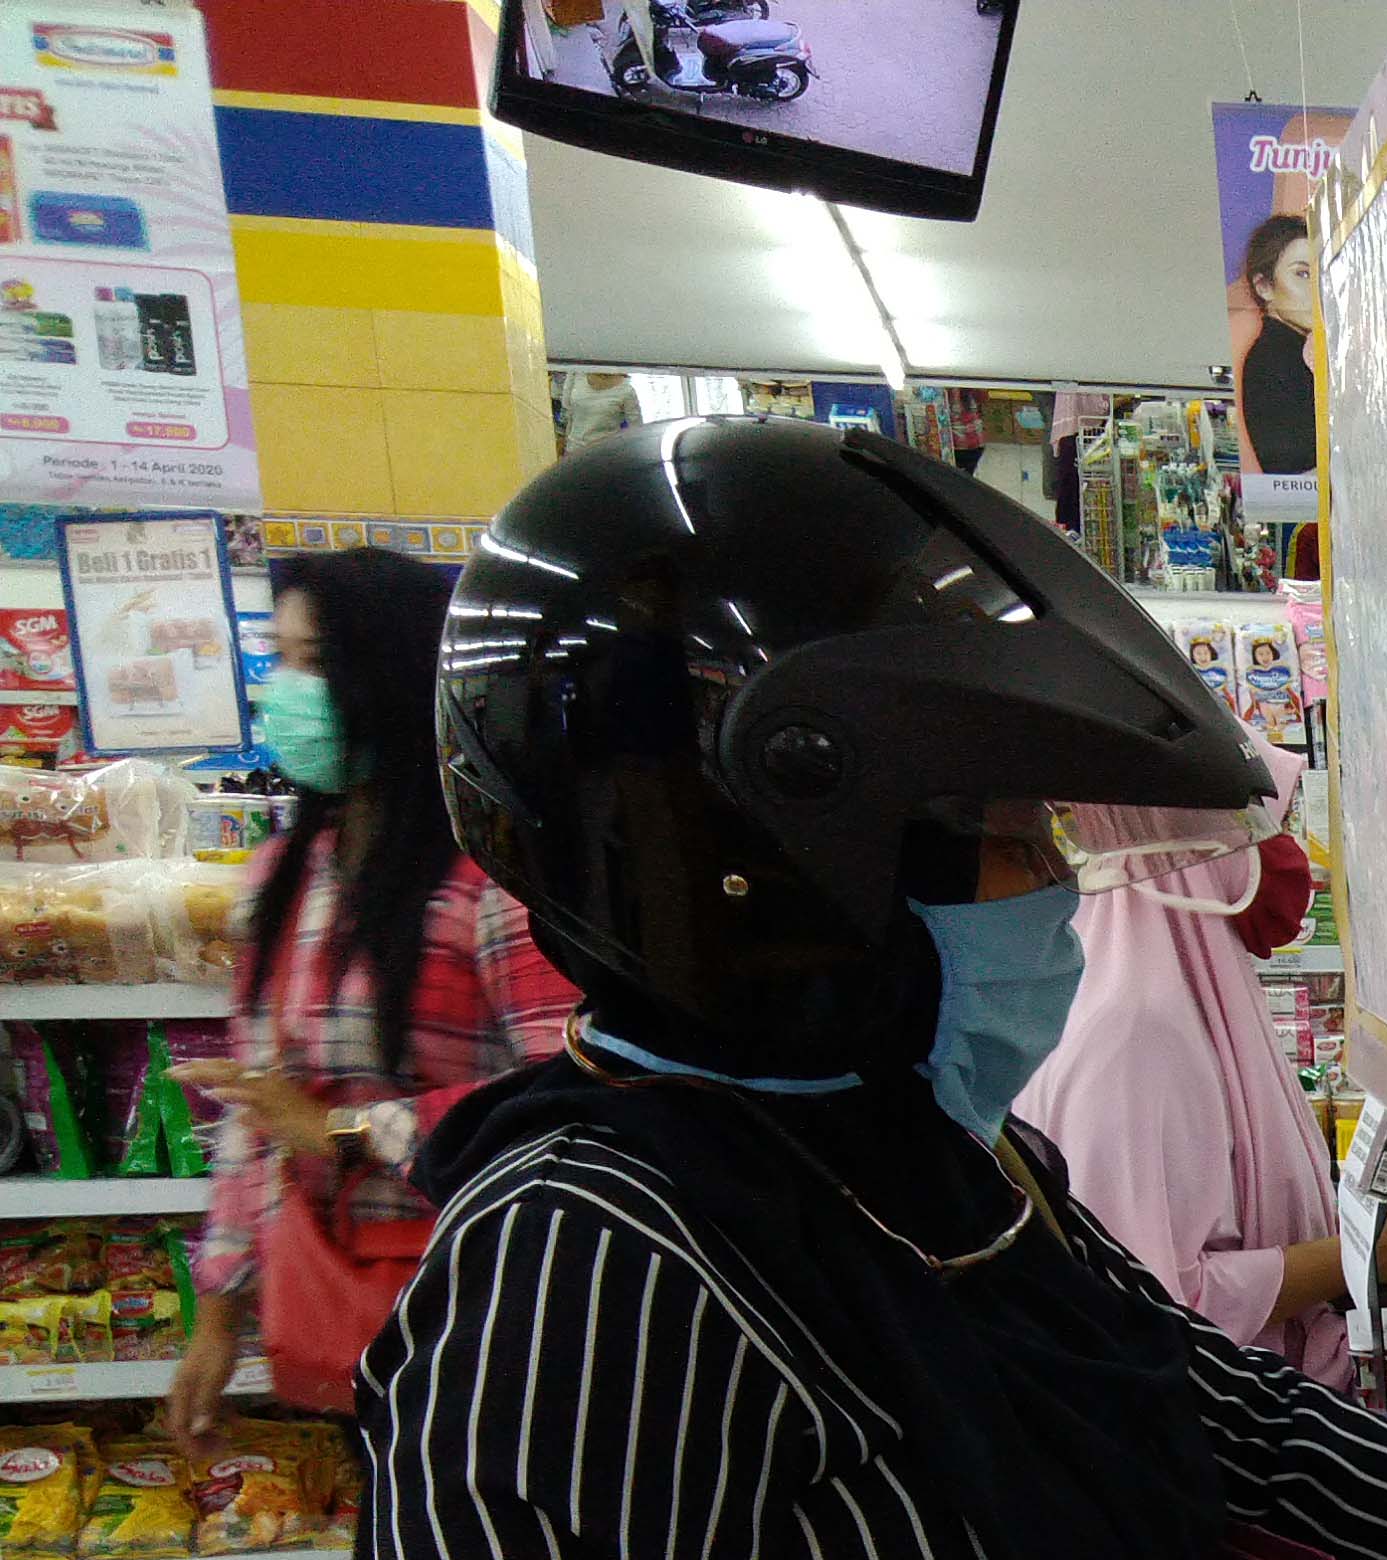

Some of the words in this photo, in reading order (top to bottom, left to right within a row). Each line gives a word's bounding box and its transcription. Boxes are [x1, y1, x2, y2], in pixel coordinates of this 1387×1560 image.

[43, 454, 99, 470] Periode
[131, 460, 149, 473] 14
[151, 460, 187, 477] April
[188, 462, 224, 477] 2020
[76, 550, 119, 575] Beli
[119, 550, 133, 572] 1
[135, 549, 195, 571] Gratis
[197, 547, 212, 569] 1
[14, 614, 59, 635] SGM
